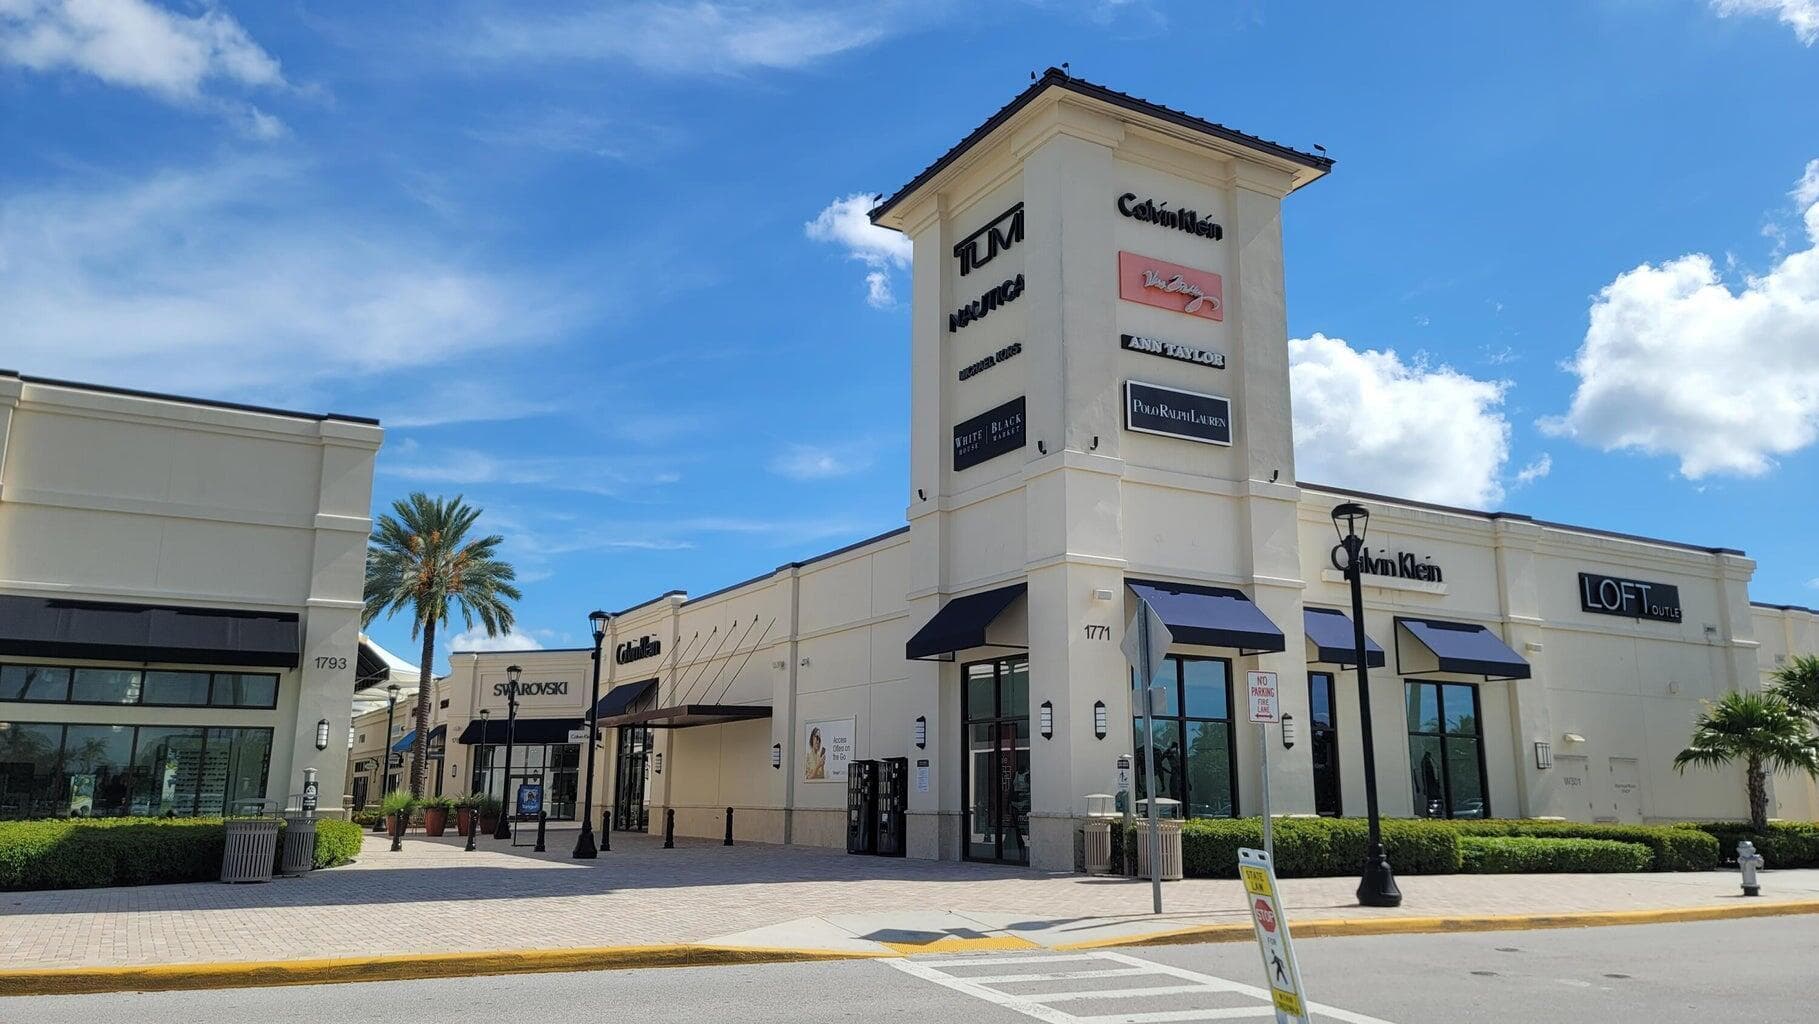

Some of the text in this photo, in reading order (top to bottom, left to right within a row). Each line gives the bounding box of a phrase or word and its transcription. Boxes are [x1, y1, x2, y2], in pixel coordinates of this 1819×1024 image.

[1118, 193, 1223, 241] Calvin Klein
[954, 202, 1024, 276] TUMI
[949, 273, 1024, 333] NAUTICA
[959, 343, 1021, 381] MICHAEL KORS
[1128, 336, 1224, 366] ANN TAYLOR
[1133, 399, 1226, 428] POLO RALPH LAUREN
[955, 413, 1022, 448] WHITE BLACK
[1398, 552, 1443, 582] Klein
[1584, 577, 1652, 614] LOFT
[1084, 624, 1110, 640] 1771
[315, 656, 347, 670] 1793
[1251, 687, 1275, 698] PARKING
[1257, 676, 1268, 686] NO
[1258, 698, 1269, 706] FIRE
[1245, 870, 1264, 881] STATE
[1256, 909, 1274, 923] STOP
